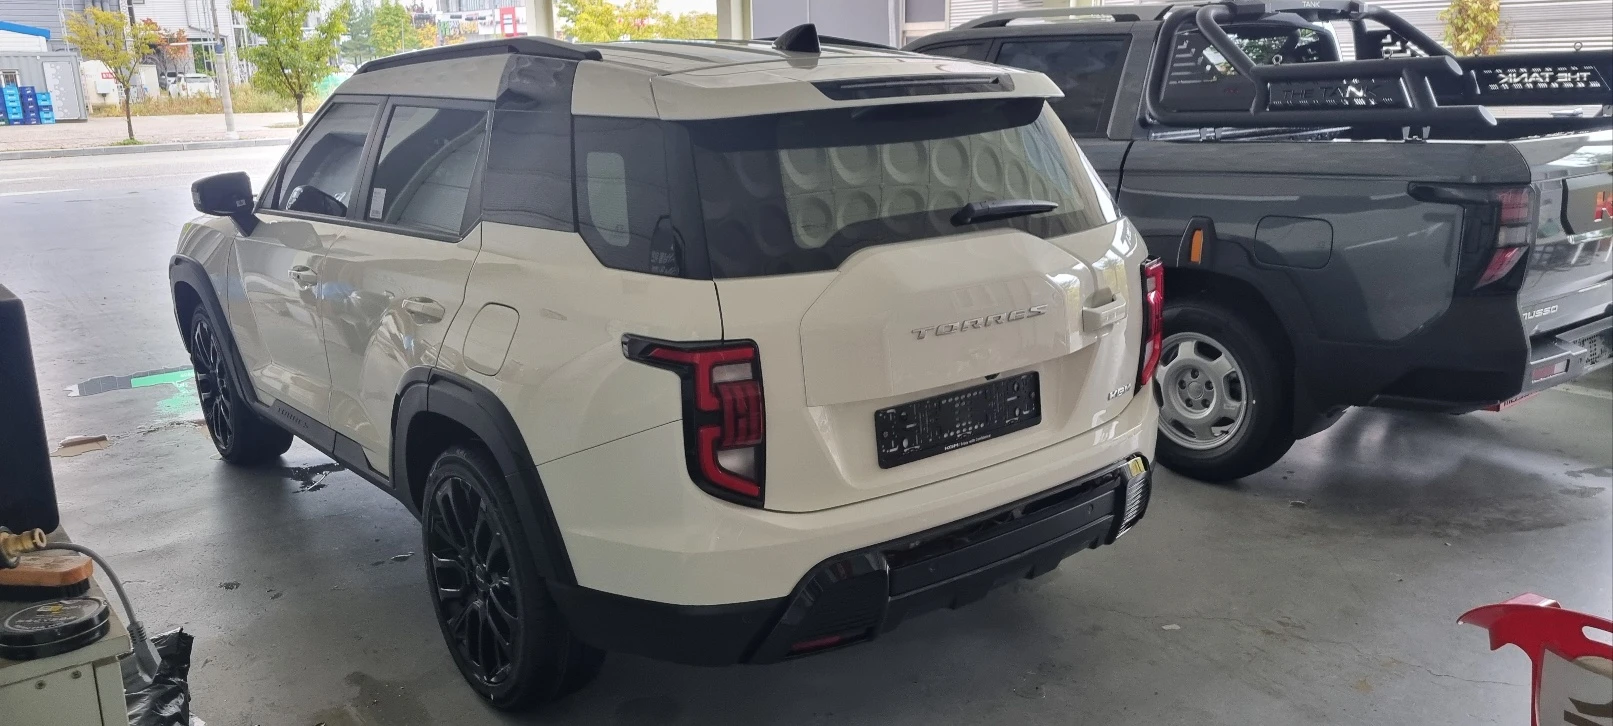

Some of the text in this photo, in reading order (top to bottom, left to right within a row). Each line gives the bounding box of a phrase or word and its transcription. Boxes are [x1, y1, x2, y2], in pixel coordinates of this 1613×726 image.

[1301, 0, 1321, 8] TANK
[1282, 84, 1383, 99] THE TANK
[911, 304, 1048, 340] TORRES
